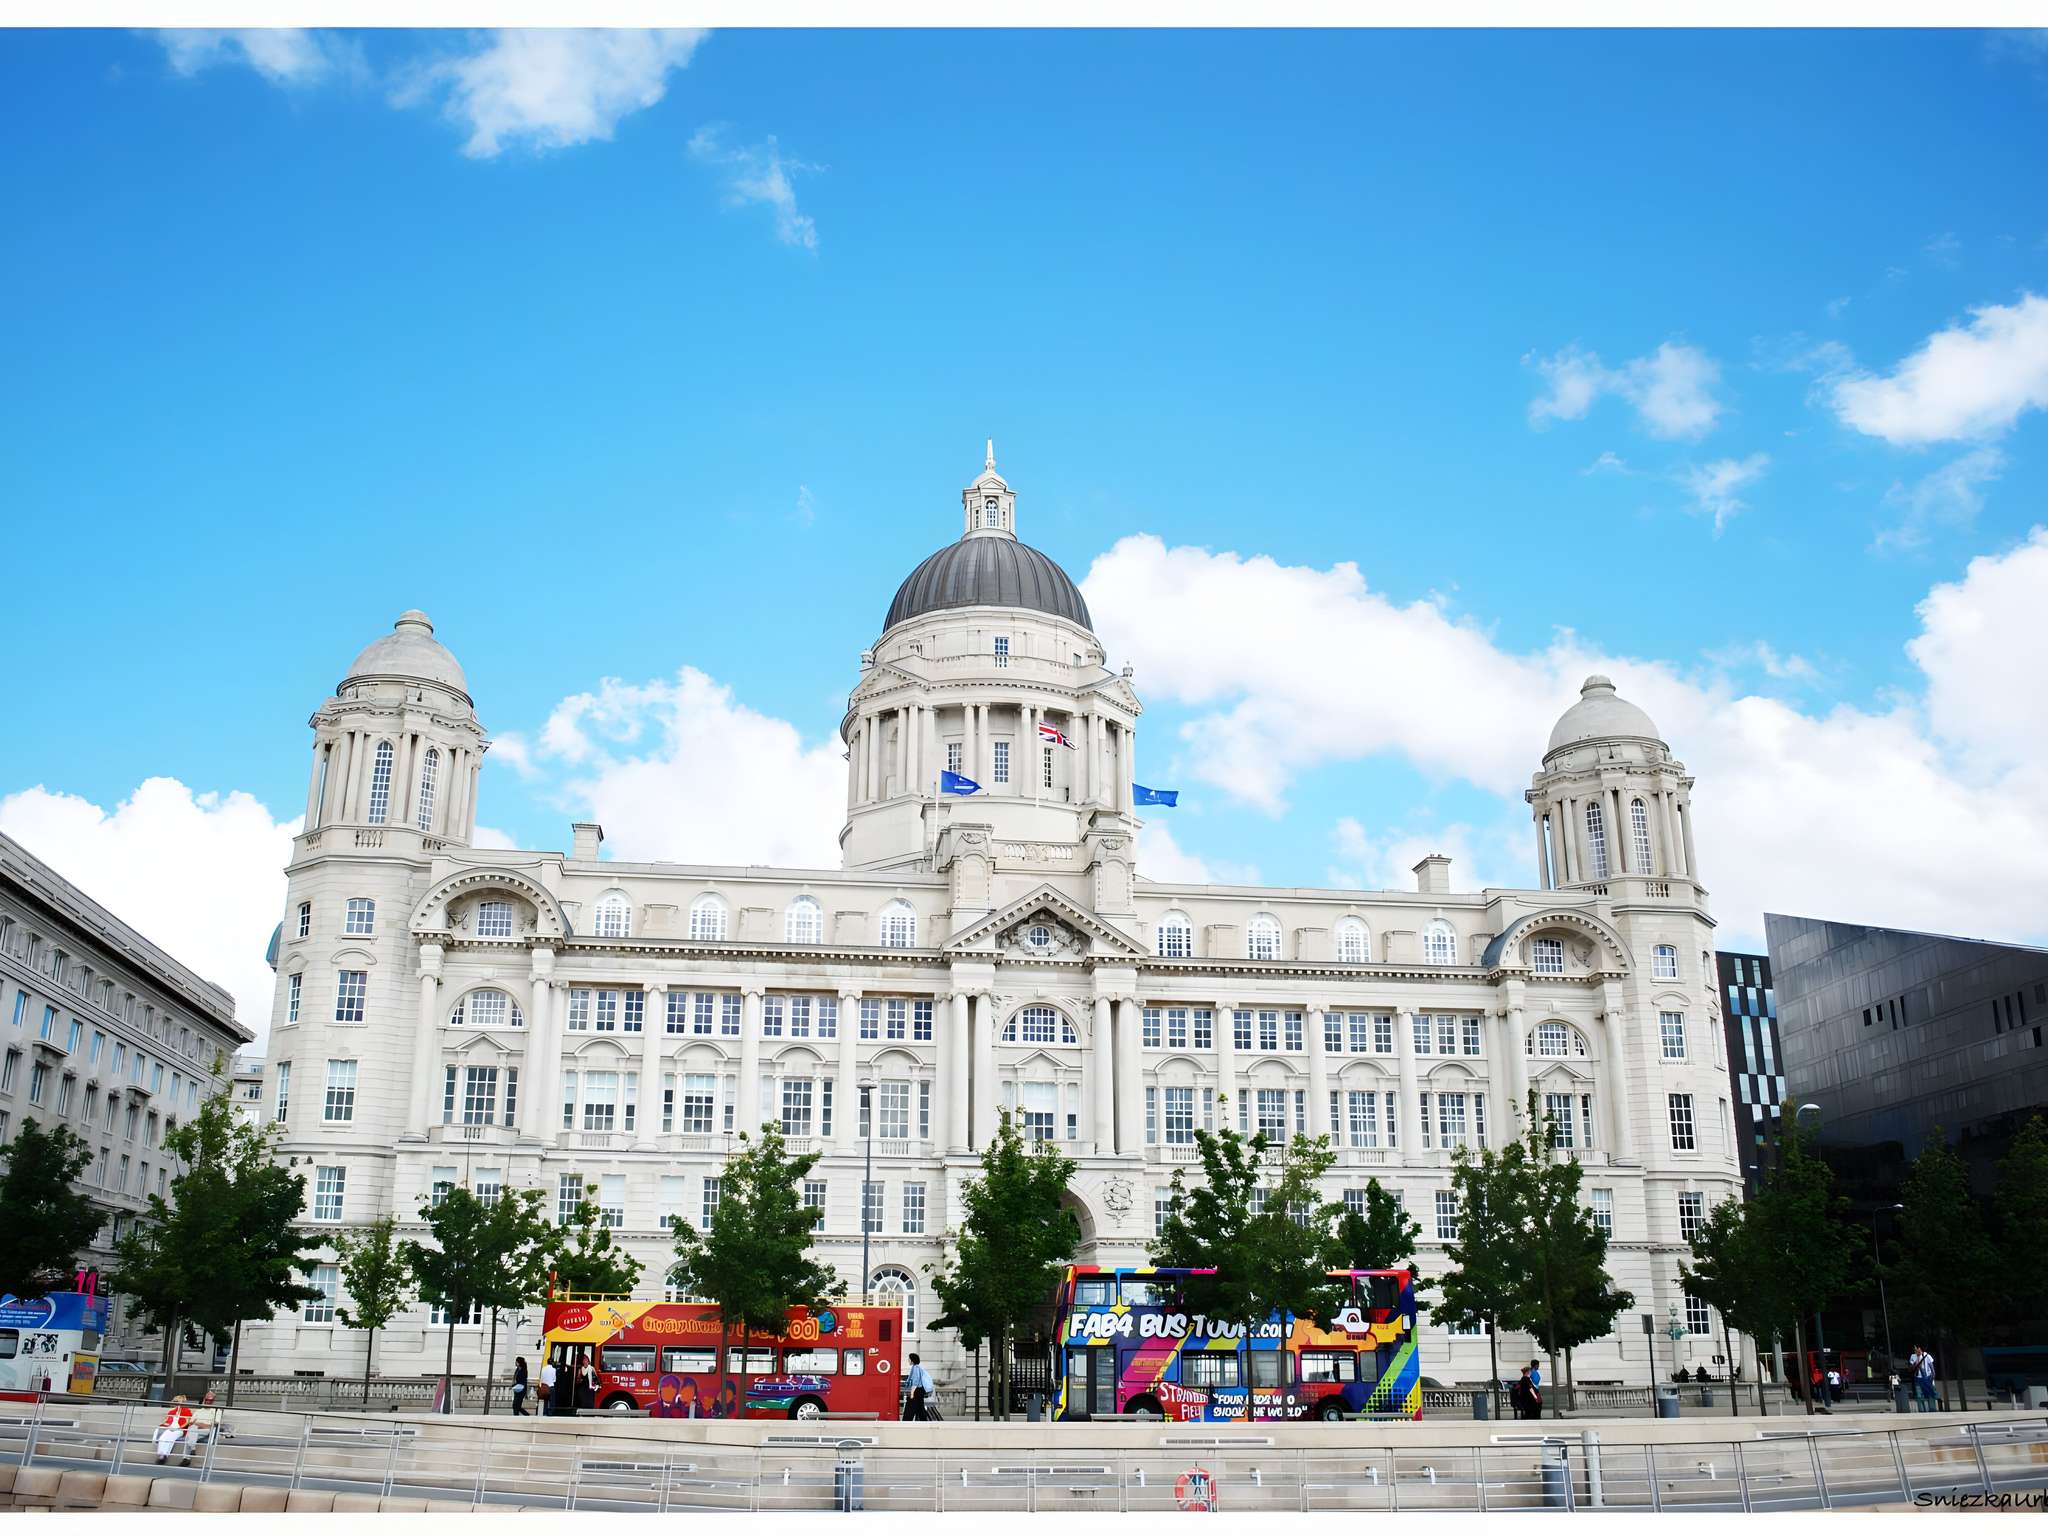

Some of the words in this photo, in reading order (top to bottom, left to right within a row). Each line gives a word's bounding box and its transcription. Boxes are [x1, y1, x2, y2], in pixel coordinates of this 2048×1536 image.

[1070, 1313, 1133, 1338] FAB4
[1140, 1313, 1187, 1338] BUS
[1273, 1394, 1295, 1405] WO
